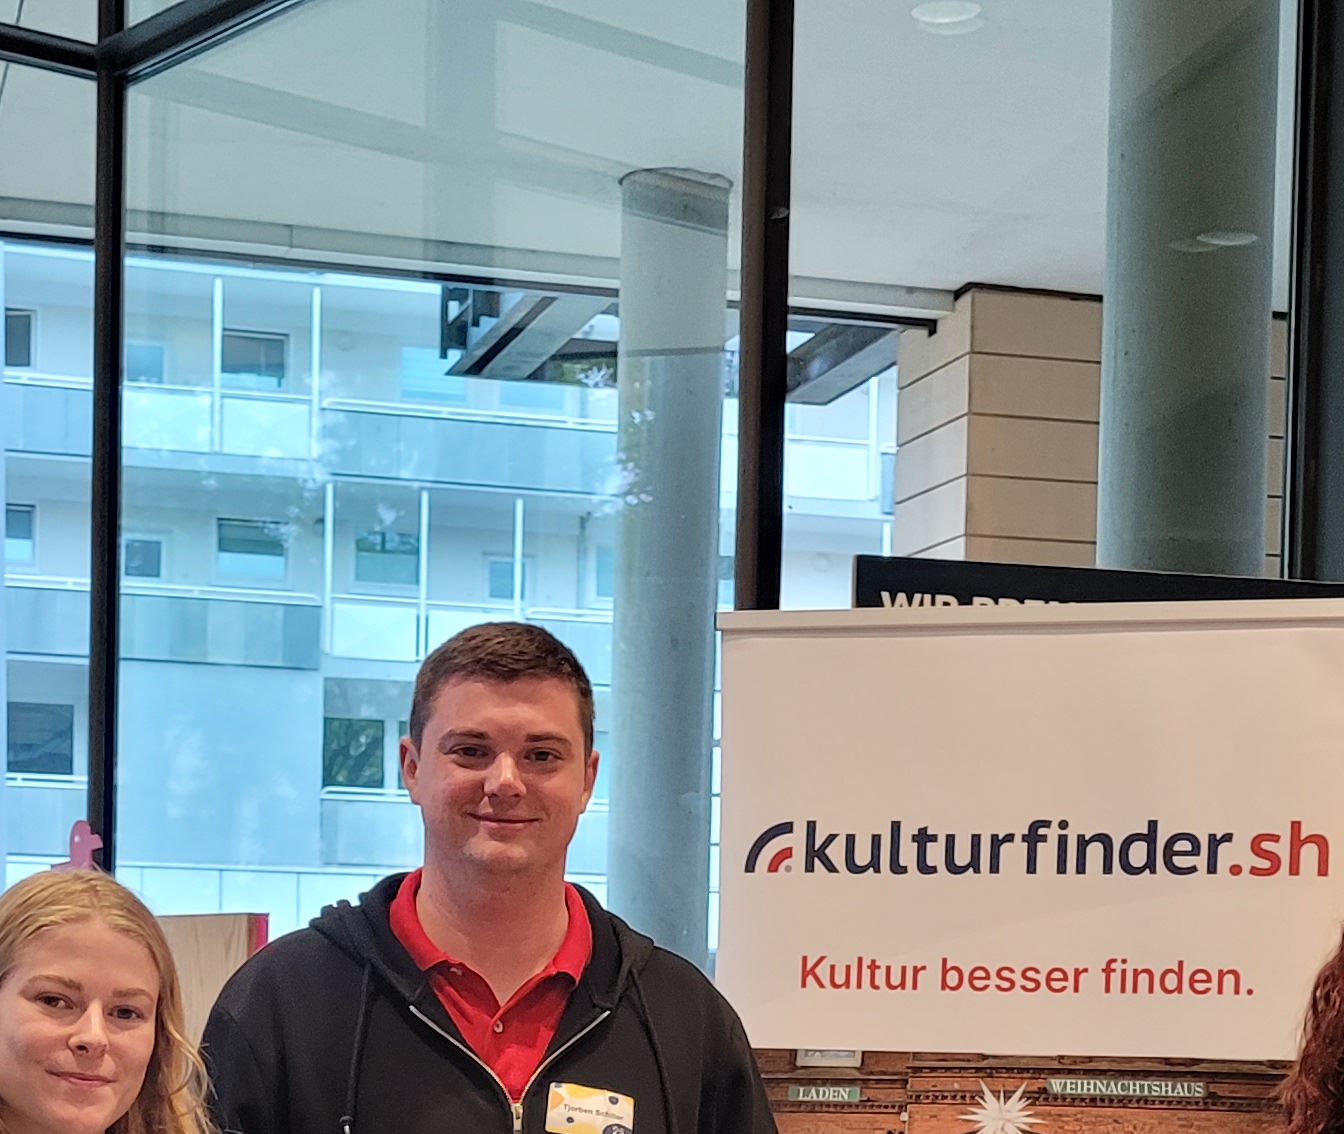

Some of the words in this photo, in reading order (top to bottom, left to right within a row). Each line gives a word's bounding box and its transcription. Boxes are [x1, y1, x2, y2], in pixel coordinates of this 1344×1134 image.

[804, 819, 1330, 877] kulturfinder.sh
[800, 955, 927, 991] Kultur
[940, 957, 1089, 994] besser
[1101, 957, 1254, 996] finden.
[798, 1087, 850, 1101] LADEN
[1050, 1080, 1204, 1097] WEIHNACHTSHAUS
